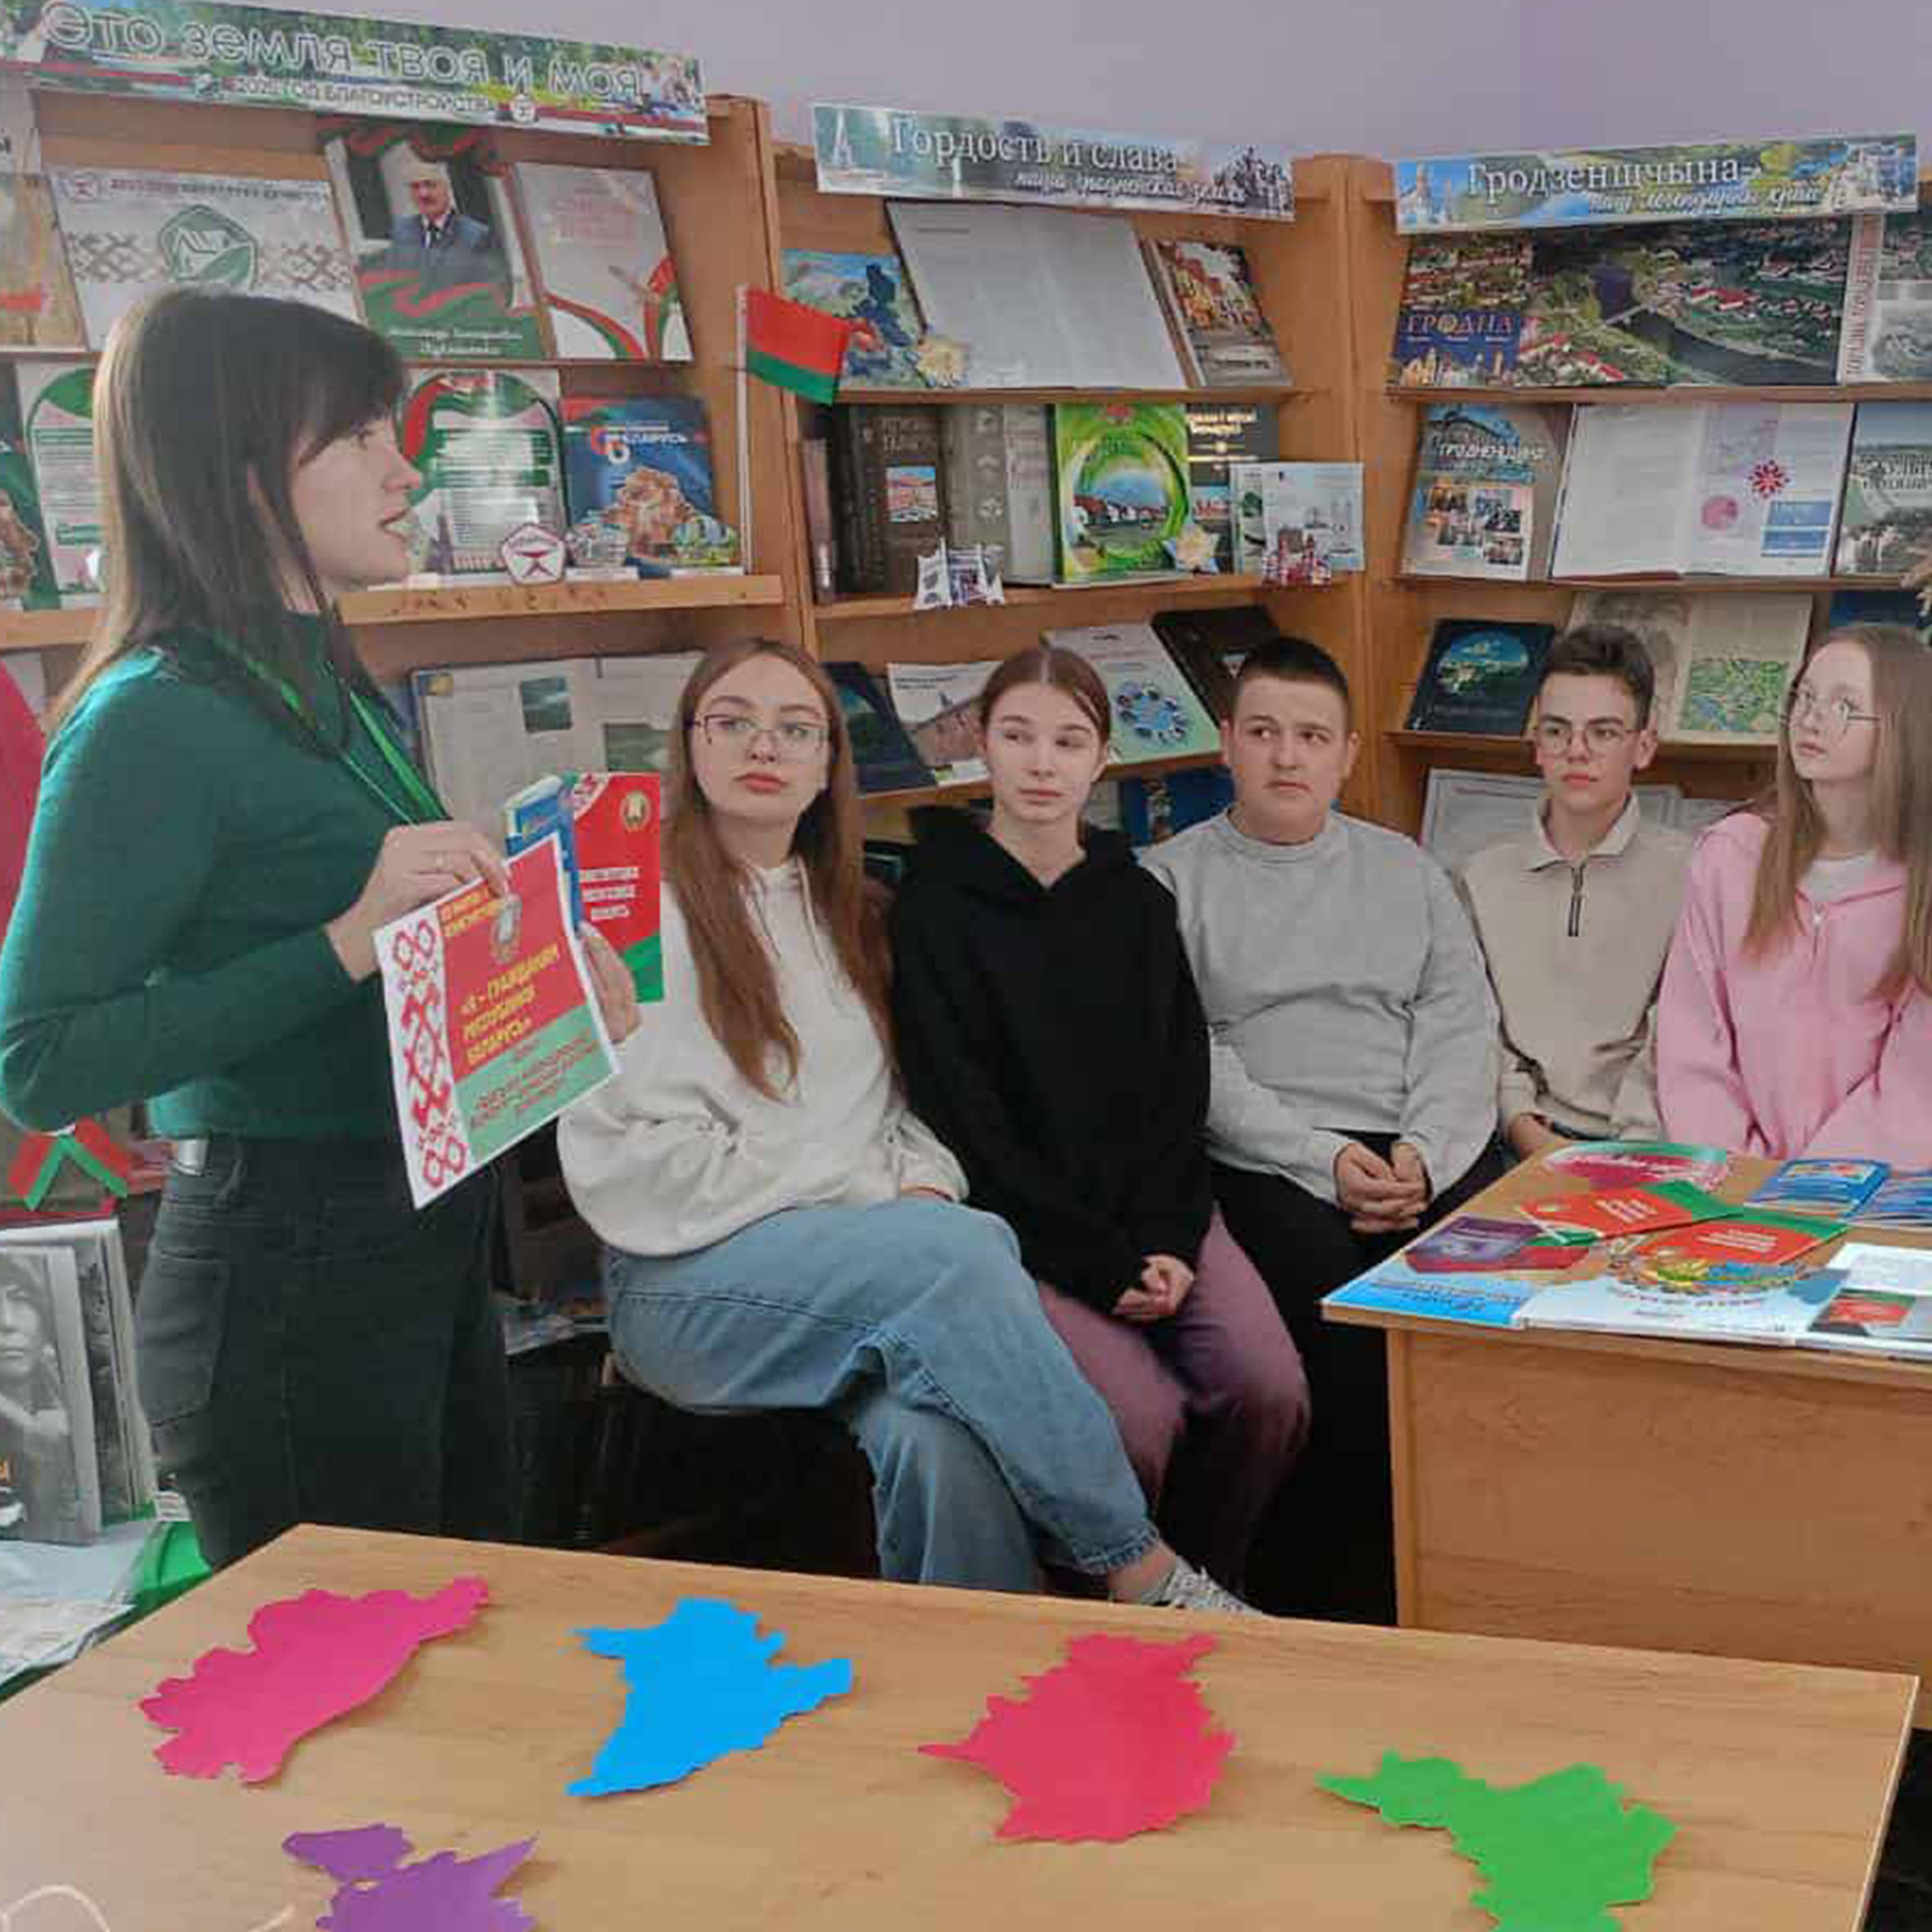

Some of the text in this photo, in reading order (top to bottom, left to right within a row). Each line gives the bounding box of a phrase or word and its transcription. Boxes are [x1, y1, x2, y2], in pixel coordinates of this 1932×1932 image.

[892, 112, 1177, 172] Гордость и слава
